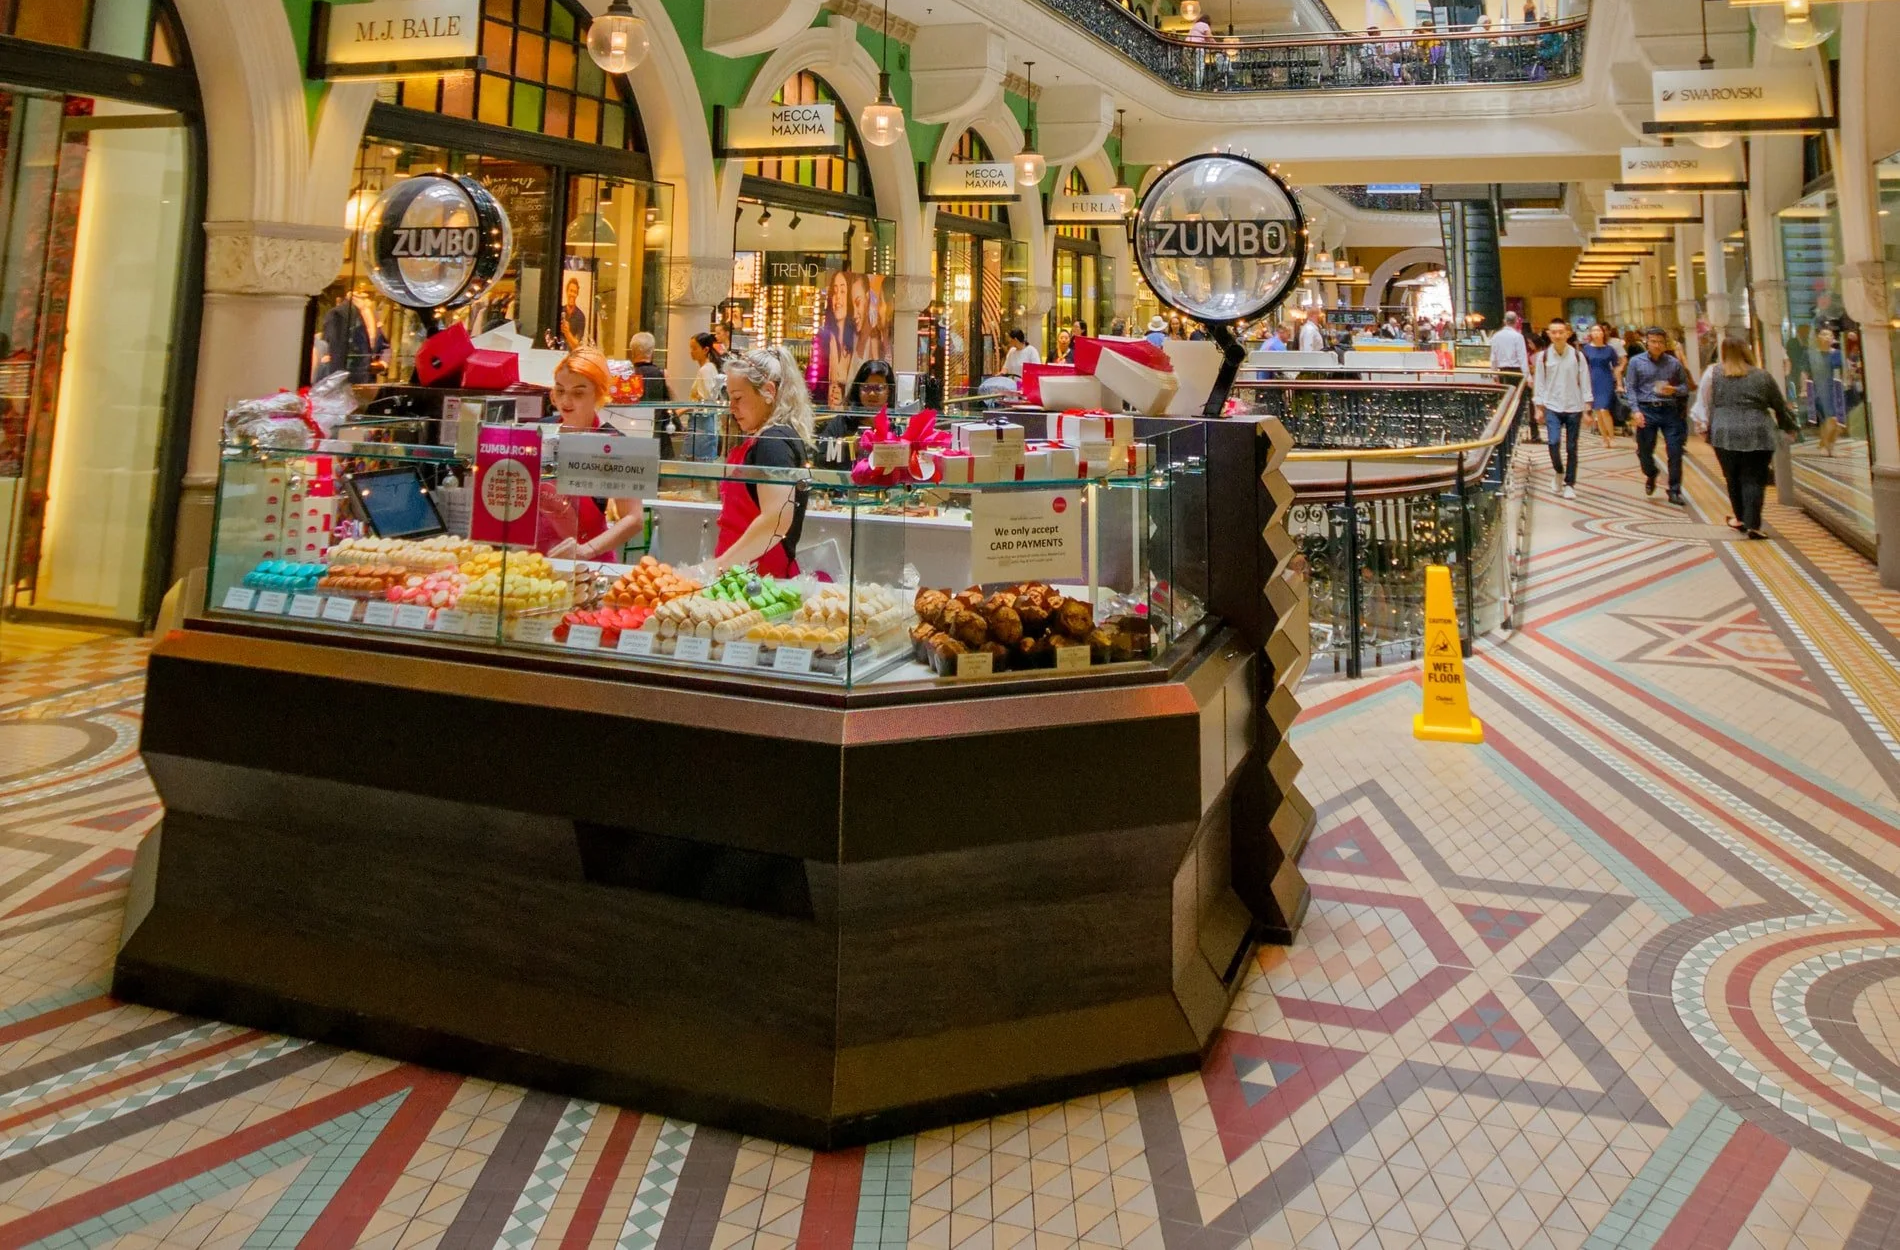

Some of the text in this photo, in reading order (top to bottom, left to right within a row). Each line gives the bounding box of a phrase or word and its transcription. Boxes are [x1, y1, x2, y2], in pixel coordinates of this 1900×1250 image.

[355, 15, 461, 42] M.J. BALE
[1680, 87, 1763, 101] SWAROVSKI
[772, 109, 821, 122] MECCA
[771, 123, 826, 136] MAXIMA
[1640, 160, 1698, 169] SWAROVSKI
[965, 168, 1005, 178] MECCA
[965, 180, 1008, 189] MAXIMA
[1072, 202, 1117, 213] FURLA
[391, 228, 478, 257] ZUMBO
[1155, 221, 1287, 256] ZUMBO
[771, 263, 819, 278] TREND
[568, 461, 580, 470] NO
[604, 464, 624, 473] CARD
[625, 465, 645, 474] ONLY
[994, 525, 1059, 537] We only accept
[990, 538, 1064, 551] CARD PAYMENTS
[1432, 662, 1454, 673] WET
[1428, 672, 1461, 684] FLOOR
